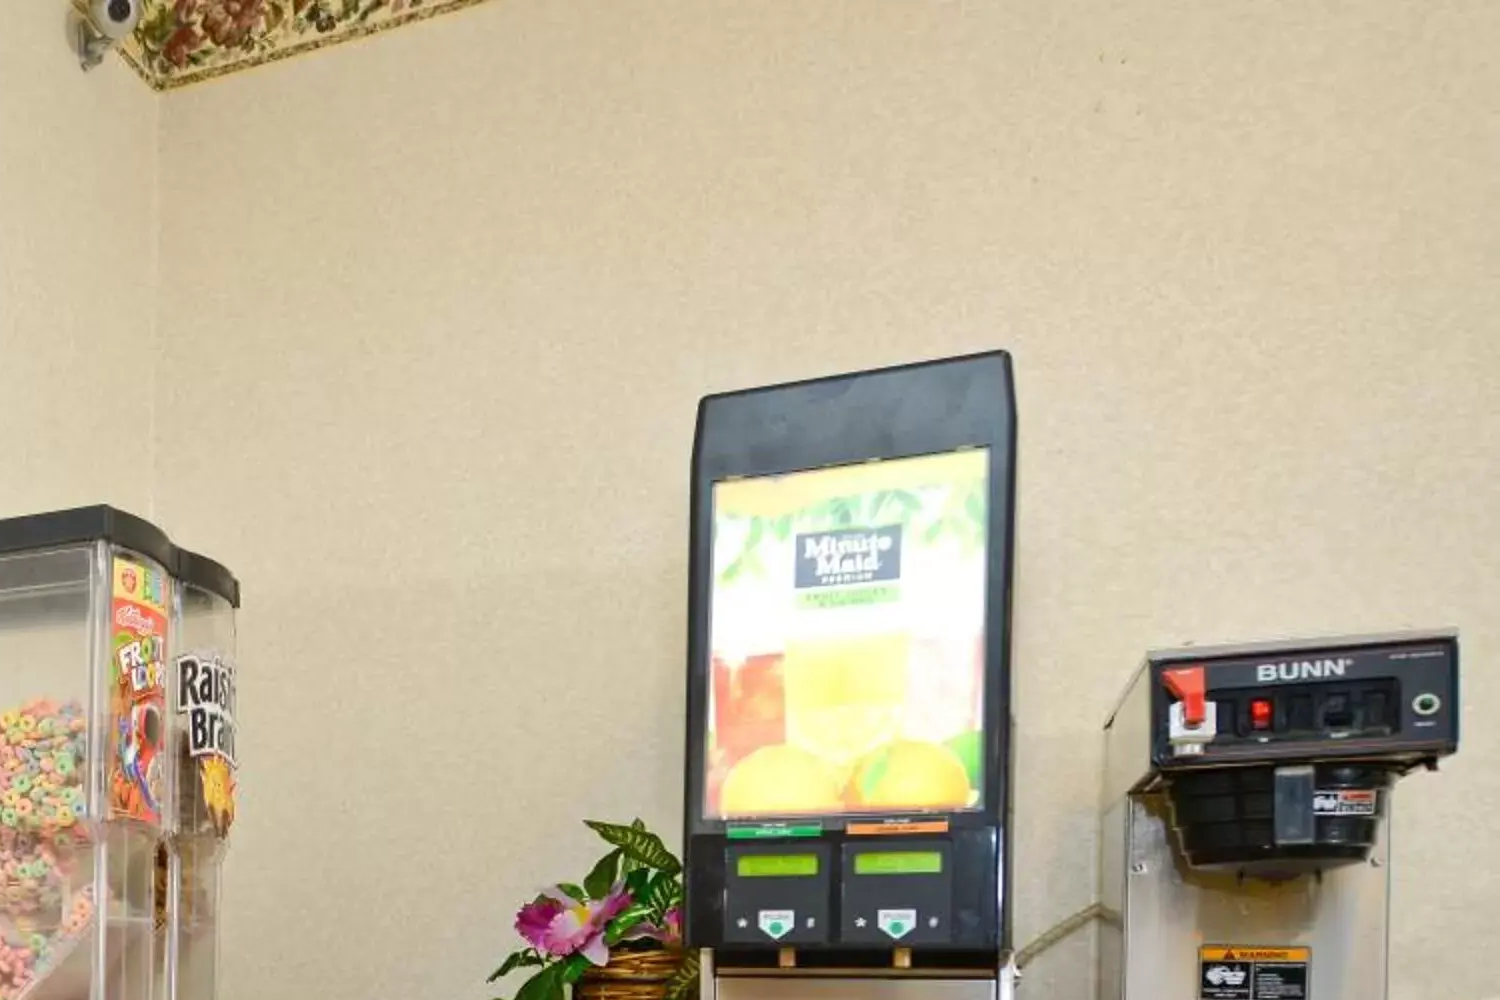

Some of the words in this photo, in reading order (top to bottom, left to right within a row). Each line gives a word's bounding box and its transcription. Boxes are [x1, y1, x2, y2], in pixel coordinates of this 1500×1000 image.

[804, 533, 892, 558] Minute
[815, 552, 879, 576] Maid
[1256, 658, 1347, 682] BUNN
[191, 708, 235, 758] Bra
